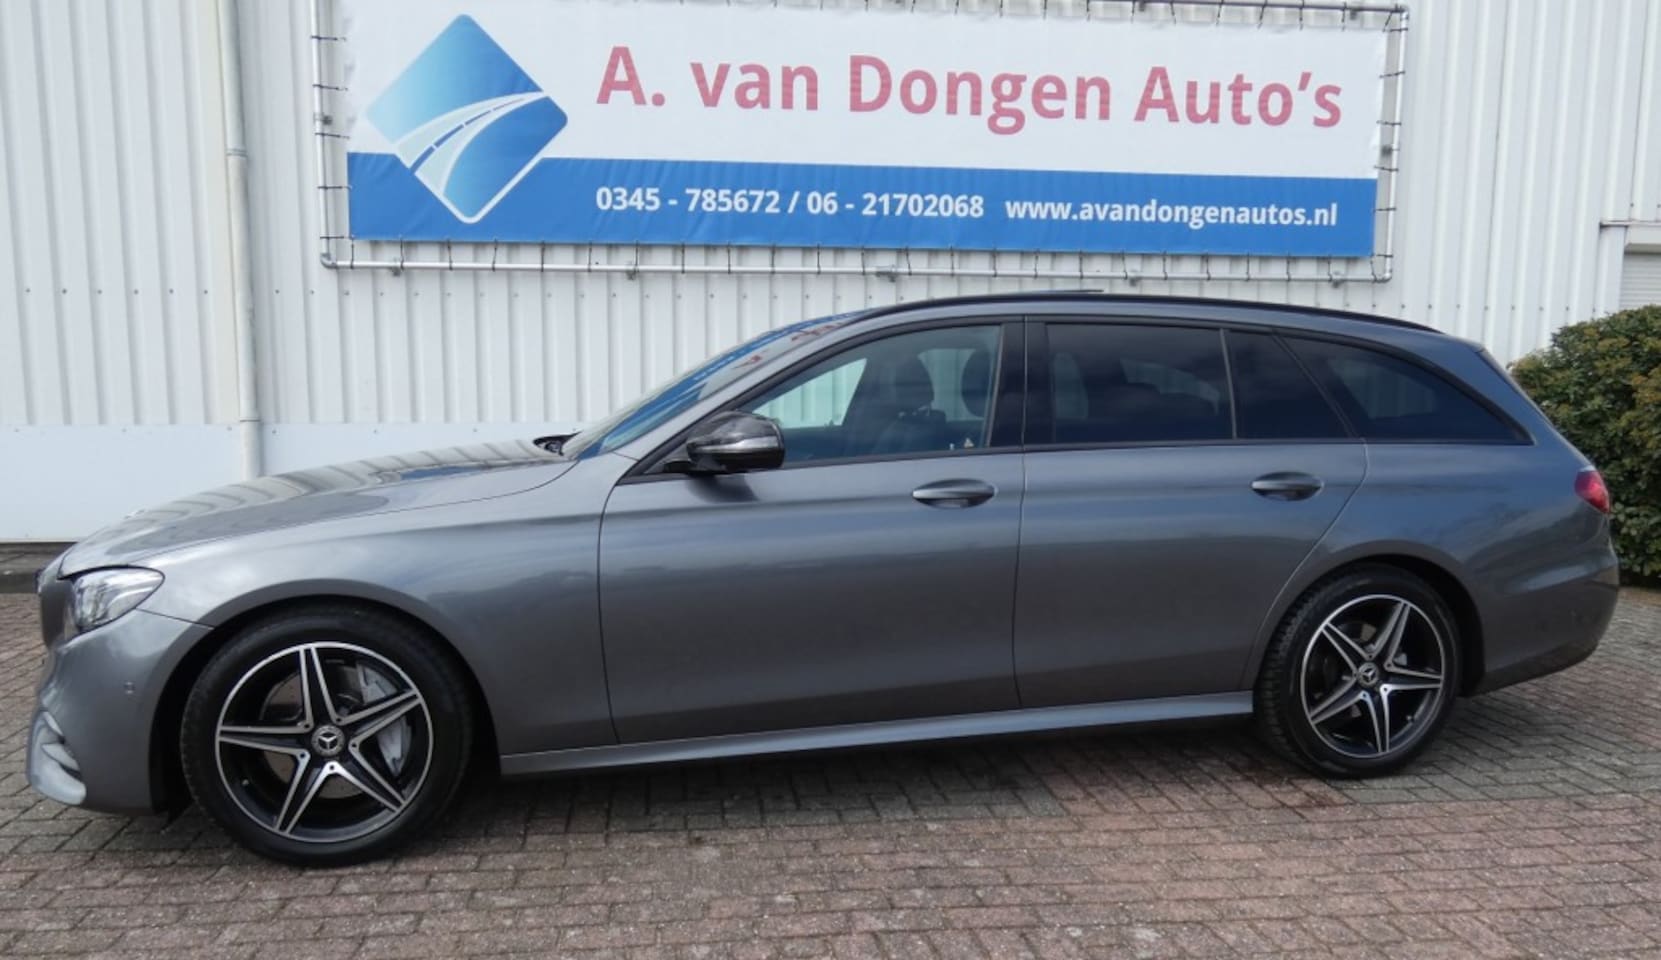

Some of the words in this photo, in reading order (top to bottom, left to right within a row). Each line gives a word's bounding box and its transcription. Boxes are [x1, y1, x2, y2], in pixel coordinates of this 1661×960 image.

[596, 46, 666, 107] A.
[690, 62, 819, 111] van
[849, 55, 1111, 136] Dongen
[596, 187, 661, 211] 0345
[685, 188, 780, 214] 785672
[787, 191, 800, 214] /
[807, 191, 838, 215] 06
[862, 192, 985, 218] 21702068
[1005, 199, 1338, 230] www.avandongenautos.nl
